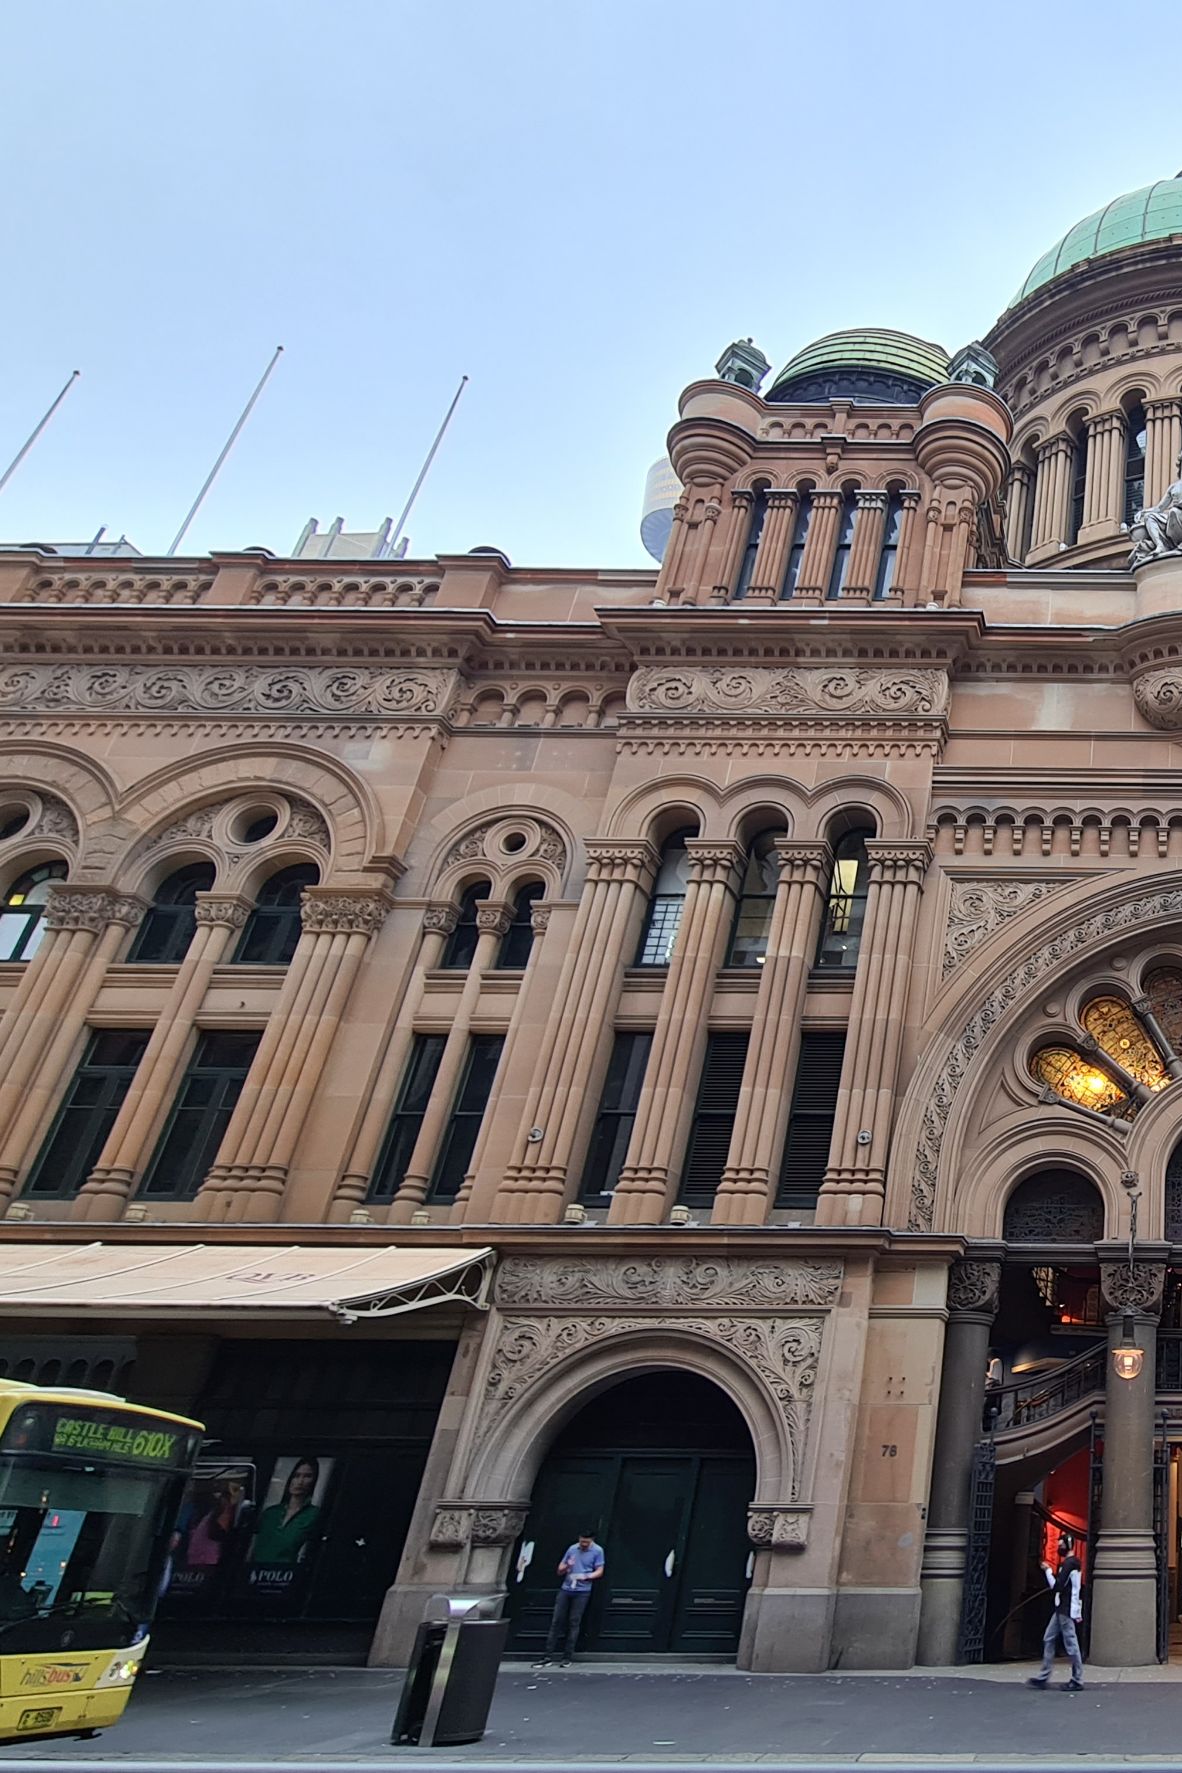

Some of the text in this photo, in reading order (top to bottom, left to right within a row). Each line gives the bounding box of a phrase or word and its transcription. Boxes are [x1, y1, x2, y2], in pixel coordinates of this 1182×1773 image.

[56, 1418, 107, 1438] CASTLE
[131, 1430, 176, 1458] 610X
[258, 1570, 294, 1581] POLO
